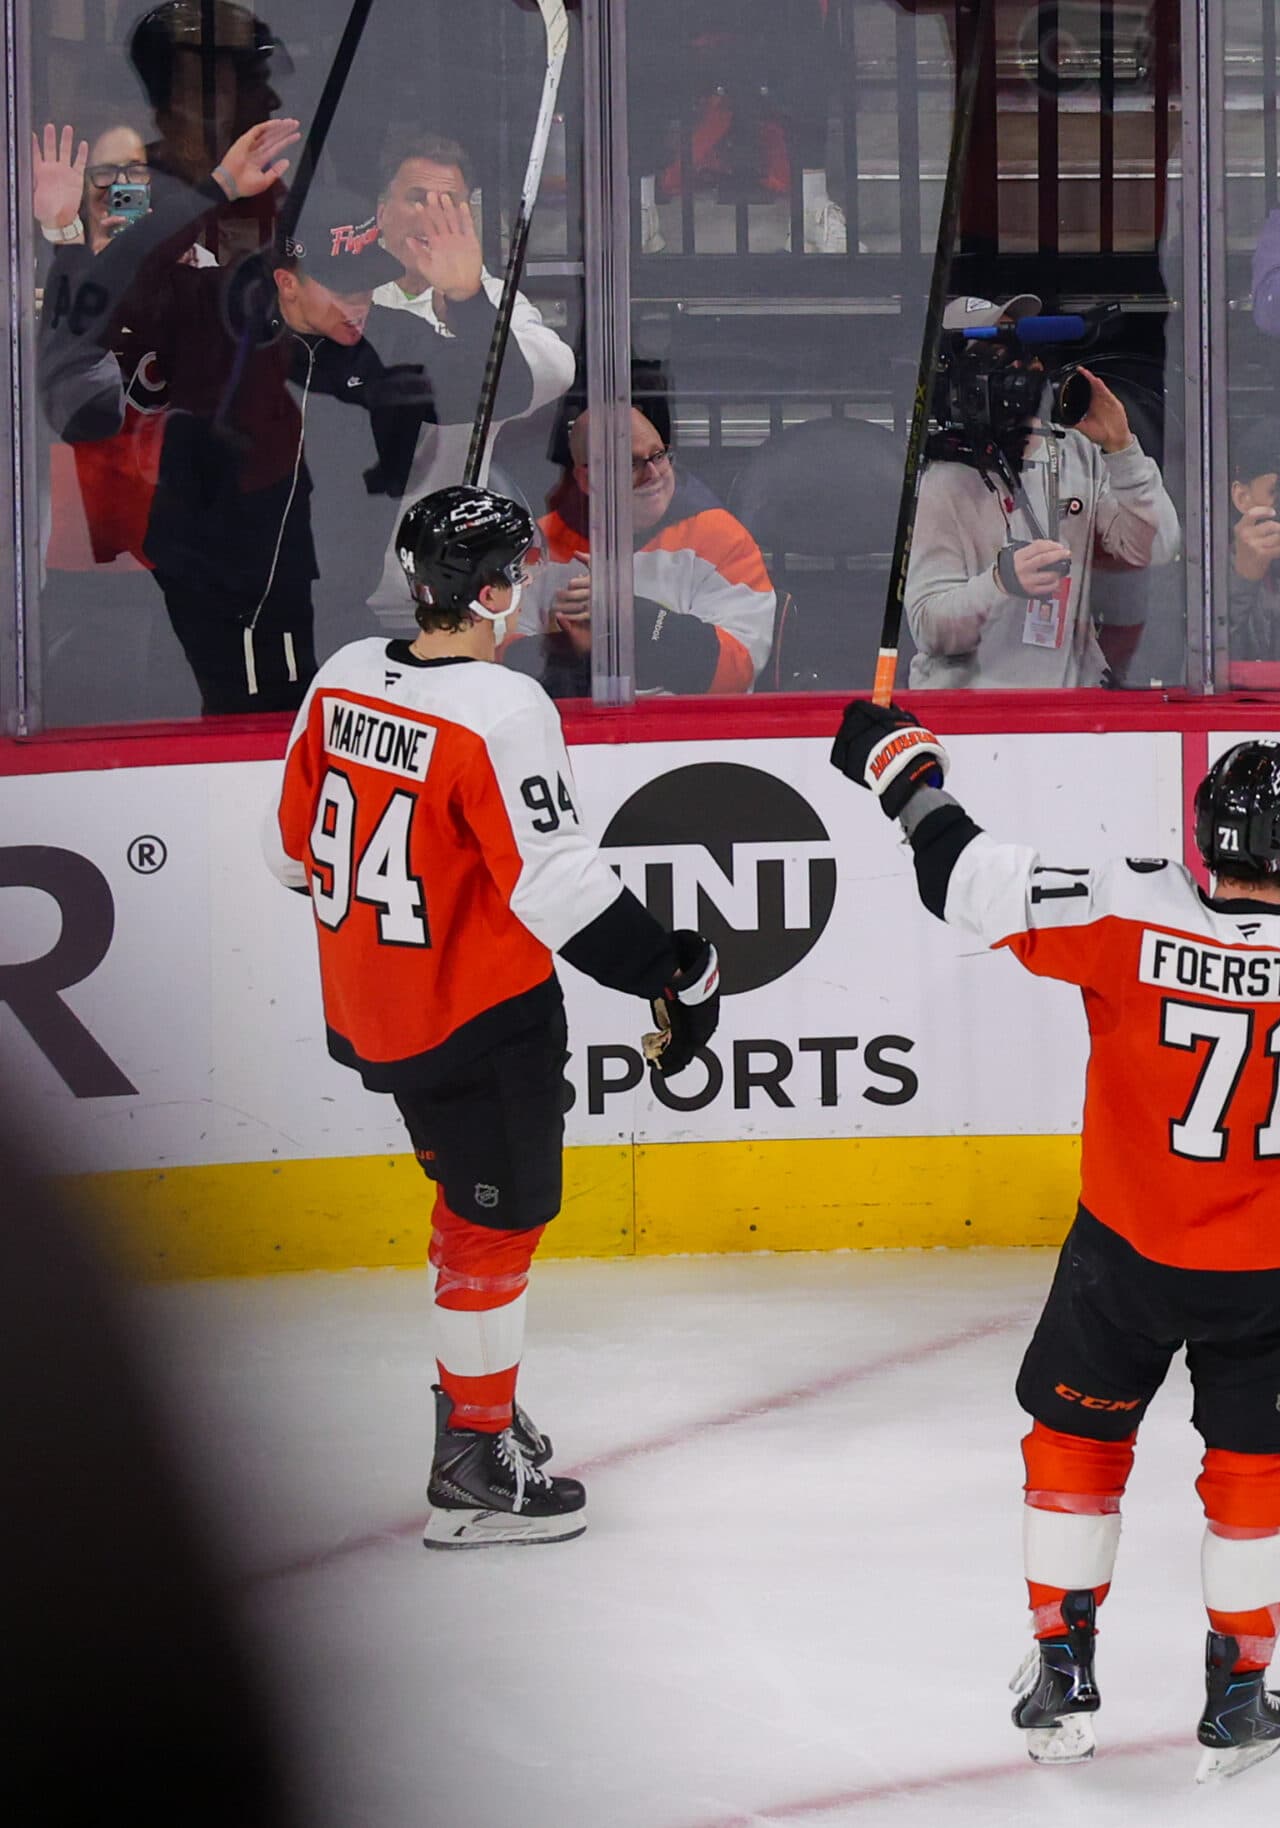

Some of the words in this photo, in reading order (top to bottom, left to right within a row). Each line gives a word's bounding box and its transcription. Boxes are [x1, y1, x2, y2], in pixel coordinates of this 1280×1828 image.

[328, 703, 428, 774] MARTONE
[308, 765, 433, 949] 94
[1217, 826, 1240, 852] 71
[597, 840, 834, 932] TNT
[0, 844, 140, 1099] R
[562, 1033, 920, 1116] PORTS
[1053, 1381, 1140, 1414] CCM
